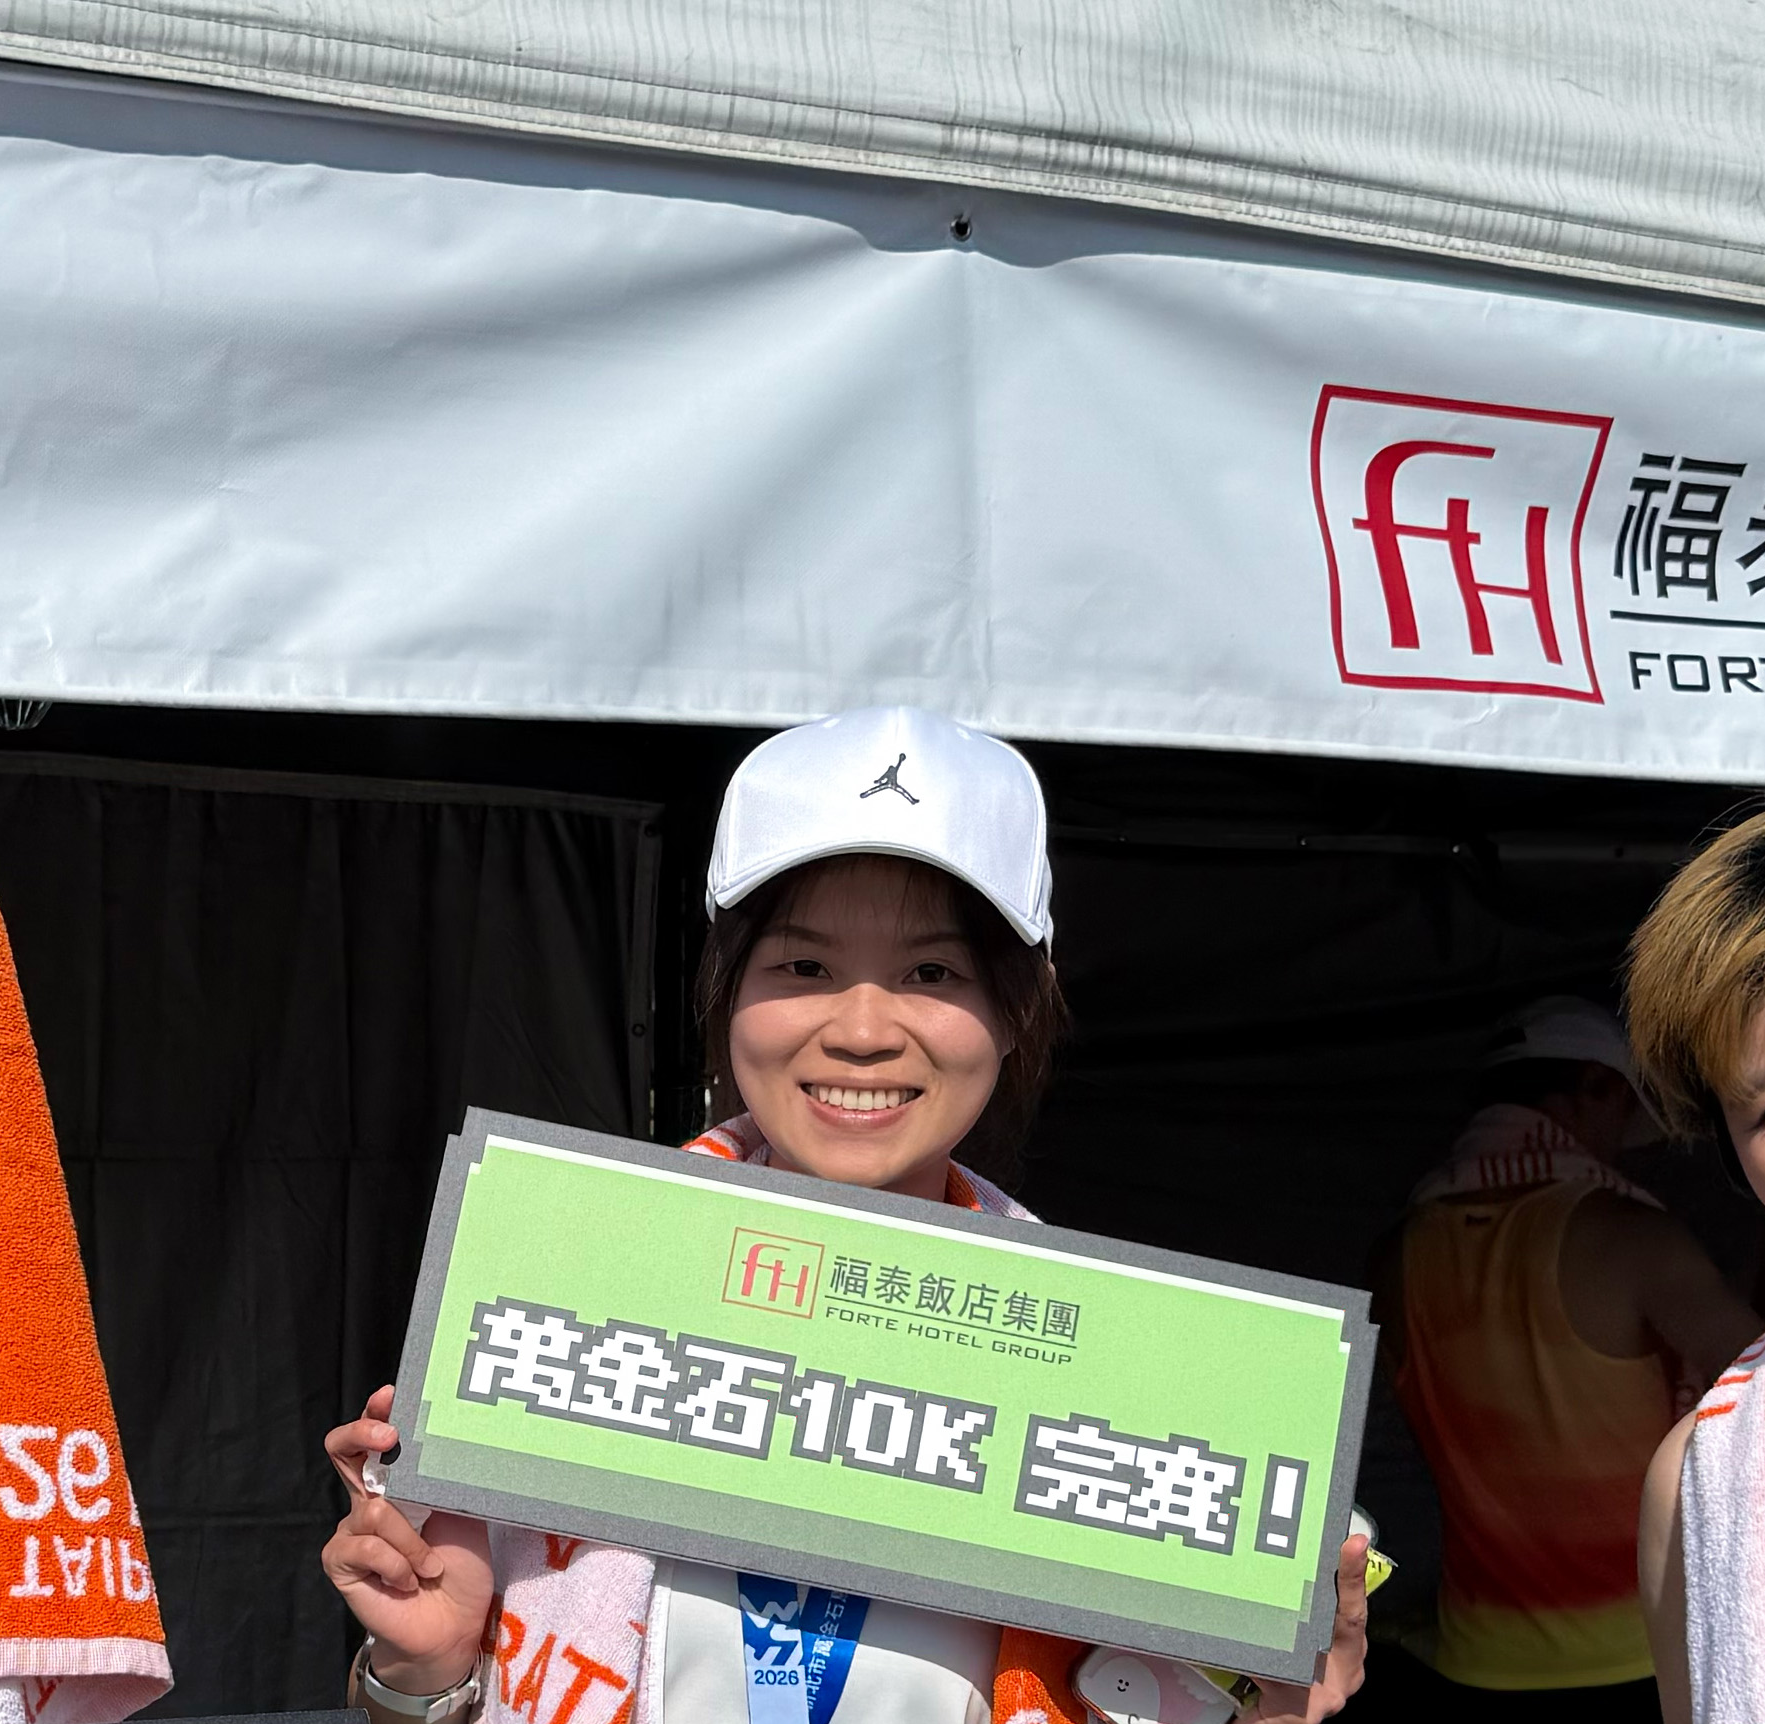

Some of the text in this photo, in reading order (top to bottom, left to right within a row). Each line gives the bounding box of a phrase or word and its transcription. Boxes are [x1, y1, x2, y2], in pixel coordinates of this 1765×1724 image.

[829, 1255, 1081, 1342] 福泰飯店集團
[825, 1305, 1073, 1366] FORTE HOTEL GROUP
[753, 1668, 800, 1686] 2026
